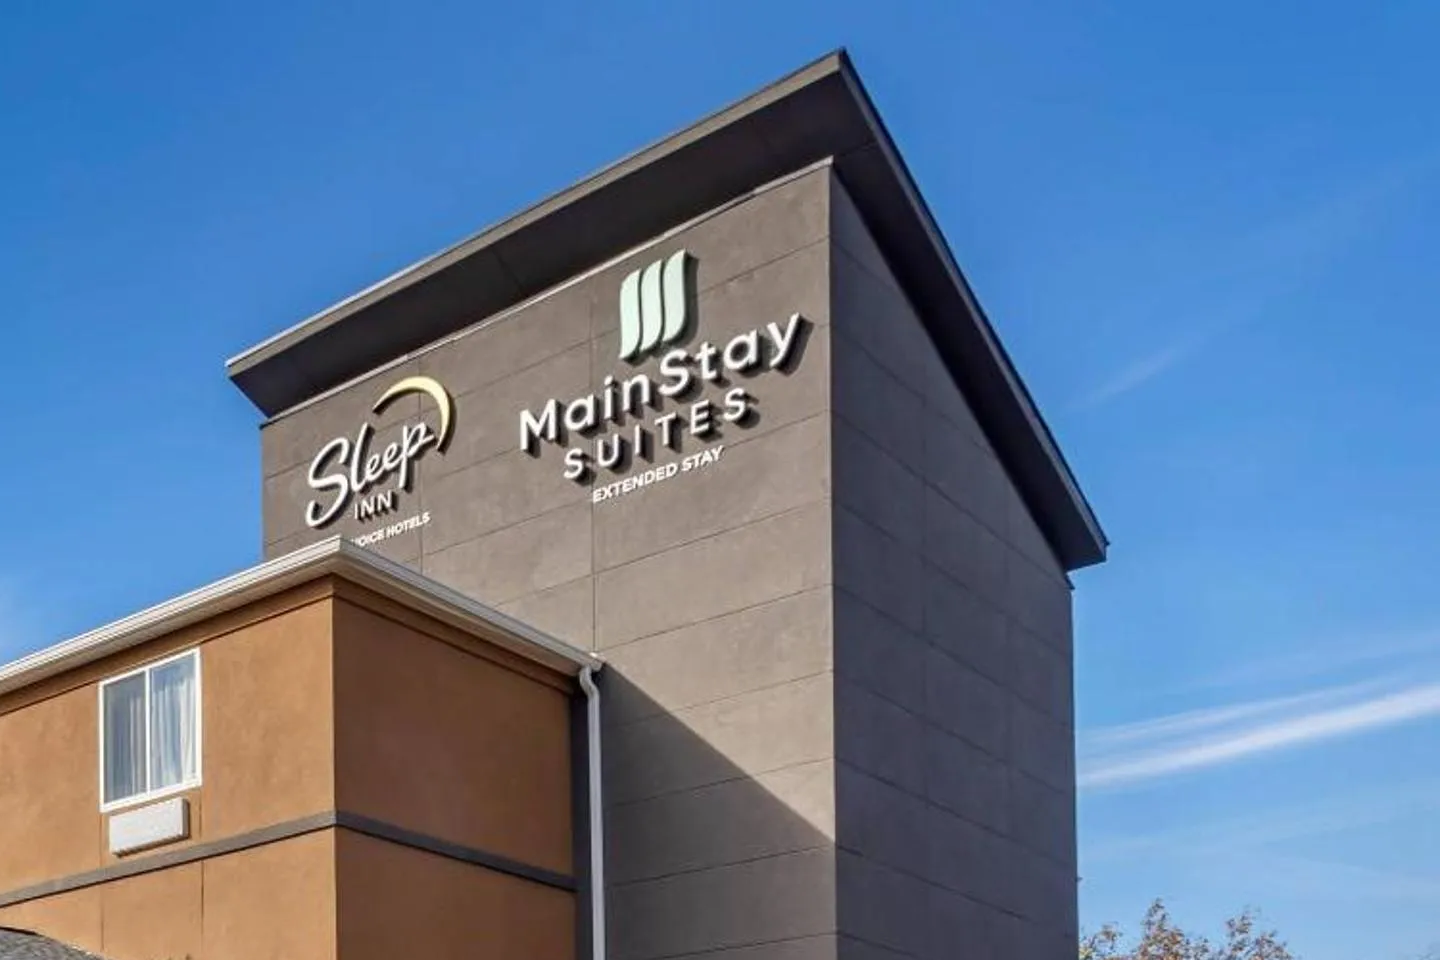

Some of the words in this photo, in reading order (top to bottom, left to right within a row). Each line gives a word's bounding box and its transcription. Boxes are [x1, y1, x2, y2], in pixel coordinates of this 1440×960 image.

[520, 312, 801, 450] MainStay
[563, 388, 747, 478] SUITES
[306, 422, 435, 527] Sleep
[355, 490, 393, 519] INN
[593, 462, 678, 503] EXTENDED
[681, 445, 725, 471] STAY
[386, 512, 430, 539] HOTELS
